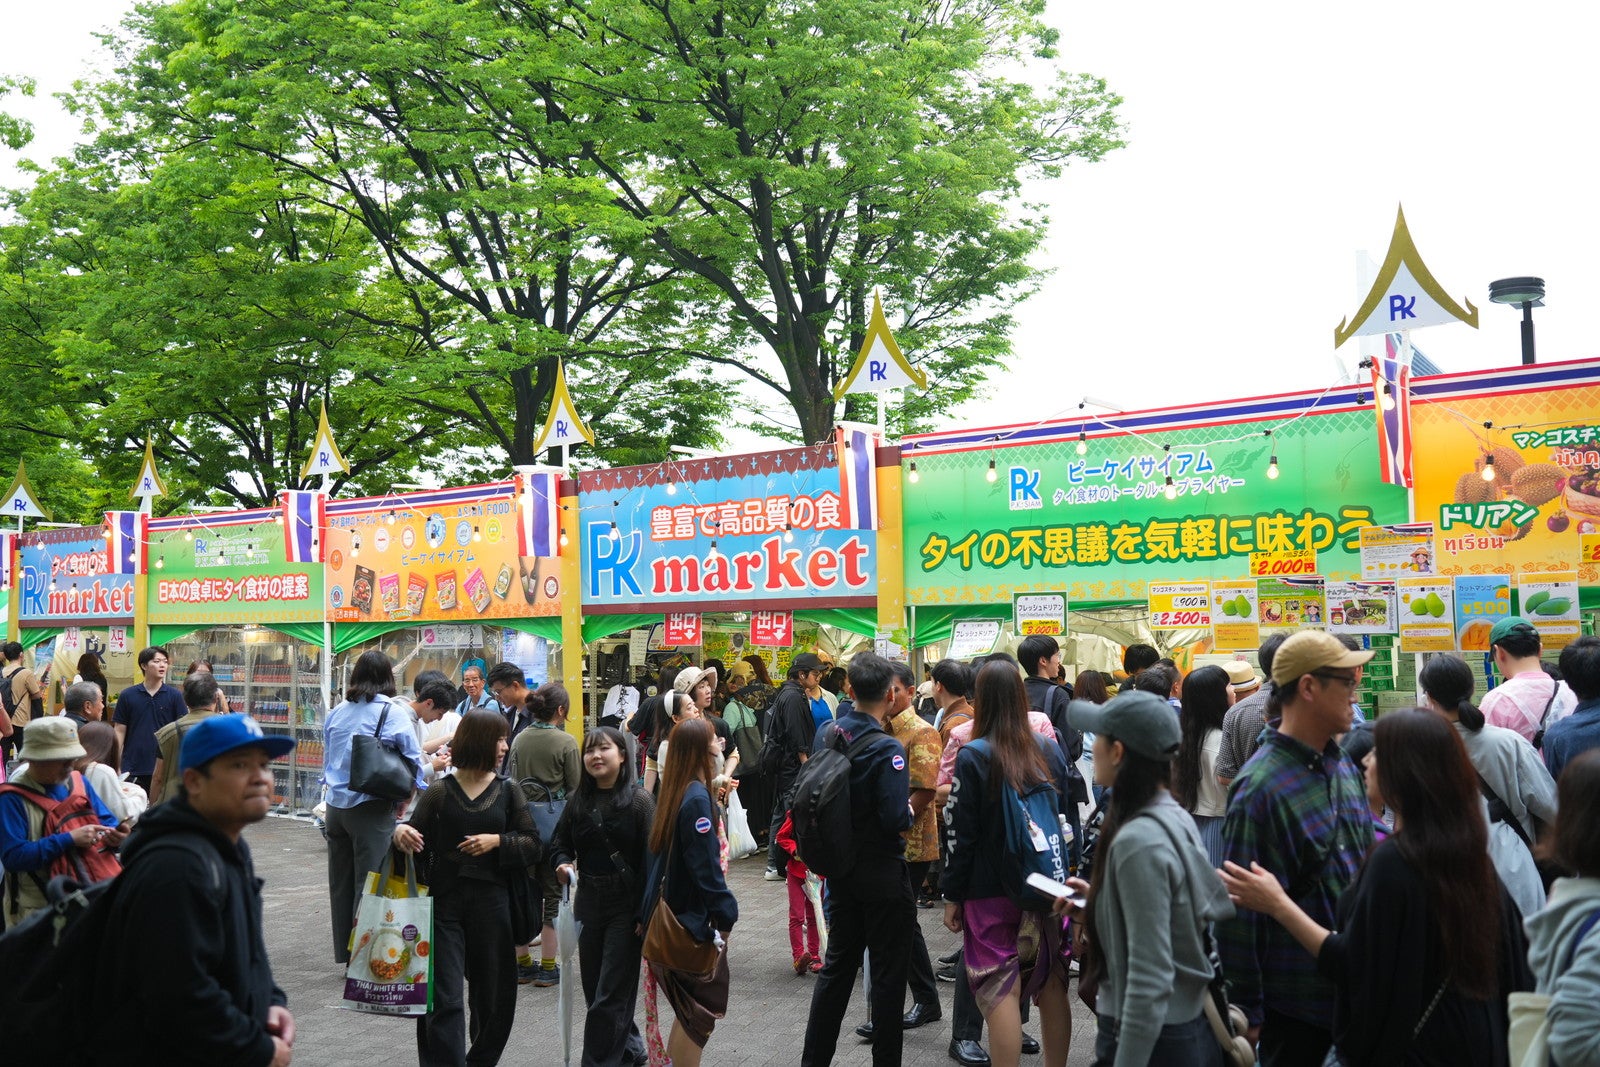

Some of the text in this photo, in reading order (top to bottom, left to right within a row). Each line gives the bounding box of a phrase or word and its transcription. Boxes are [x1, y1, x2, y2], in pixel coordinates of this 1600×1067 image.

[1390, 295, 1416, 321] PK
[869, 360, 887, 381] PK
[556, 420, 568, 438] PK
[1513, 426, 1600, 448] マンゴスチ
[1068, 451, 1213, 483] ピーケイサイアム
[1010, 467, 1040, 501] PK
[1053, 476, 1244, 505] タイ食材のトータル・プライヤー
[487, 502, 510, 515] FOOD
[651, 493, 841, 540] 豊富で高品質の食
[1442, 503, 1537, 527] ドリアン
[921, 507, 1374, 571] タイの不思議を気軽に味わう
[1444, 533, 1504, 555] ทุเรียน
[588, 521, 645, 598] PK
[650, 535, 870, 595] market
[1258, 558, 1315, 575] 2,000円
[23, 566, 46, 616] PK
[48, 579, 134, 615] market
[159, 574, 309, 603] 日本の食卓にタイ食材の提案
[1018, 604, 1063, 612] フレッシュドリアン
[1160, 611, 1210, 625] 2,500円
[1462, 601, 1509, 615] ¥500
[670, 613, 696, 630] 出口
[757, 611, 787, 630] 出口
[111, 629, 123, 641] 入口
[1048, 833, 1066, 886] didas
[356, 981, 415, 992] THAI WHITE RICE
